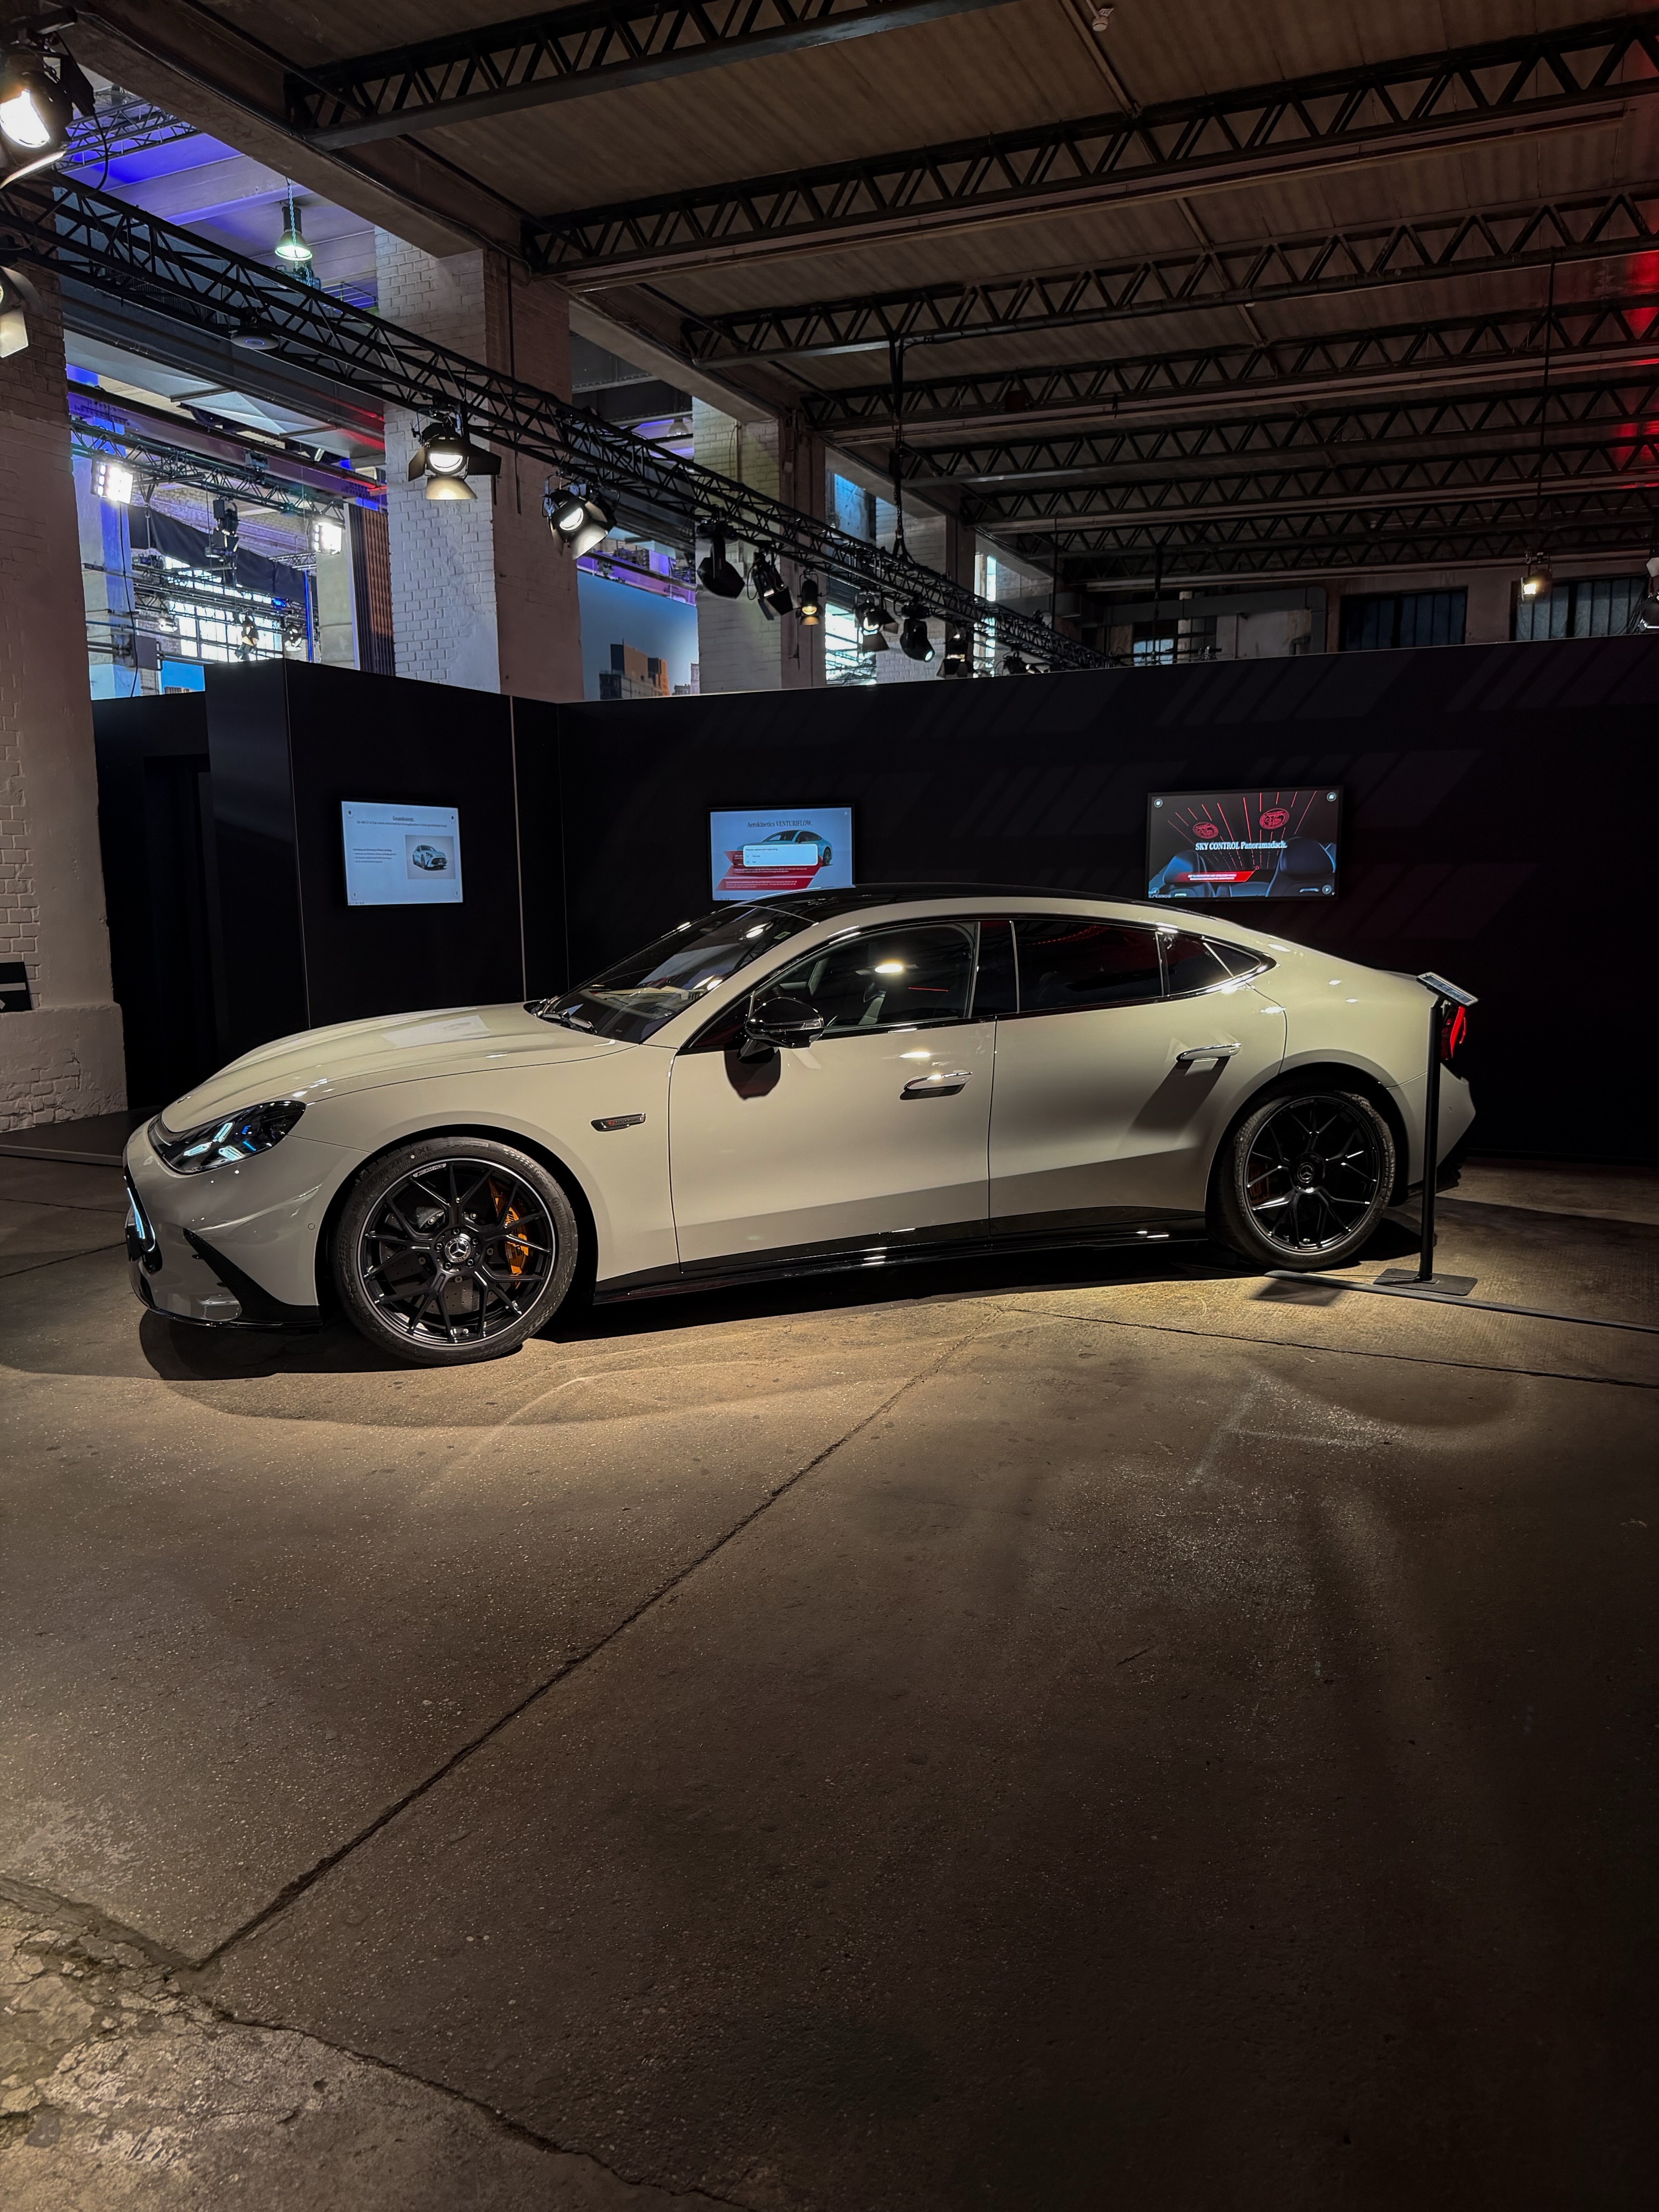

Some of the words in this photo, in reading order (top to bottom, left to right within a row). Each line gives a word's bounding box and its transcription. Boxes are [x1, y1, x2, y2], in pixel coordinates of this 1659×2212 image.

[1195, 842, 1209, 850] SKY
[1209, 841, 1240, 850] CONTROL
[1240, 840, 1287, 849] Panoramadach.
[417, 1146, 433, 1154] XL
